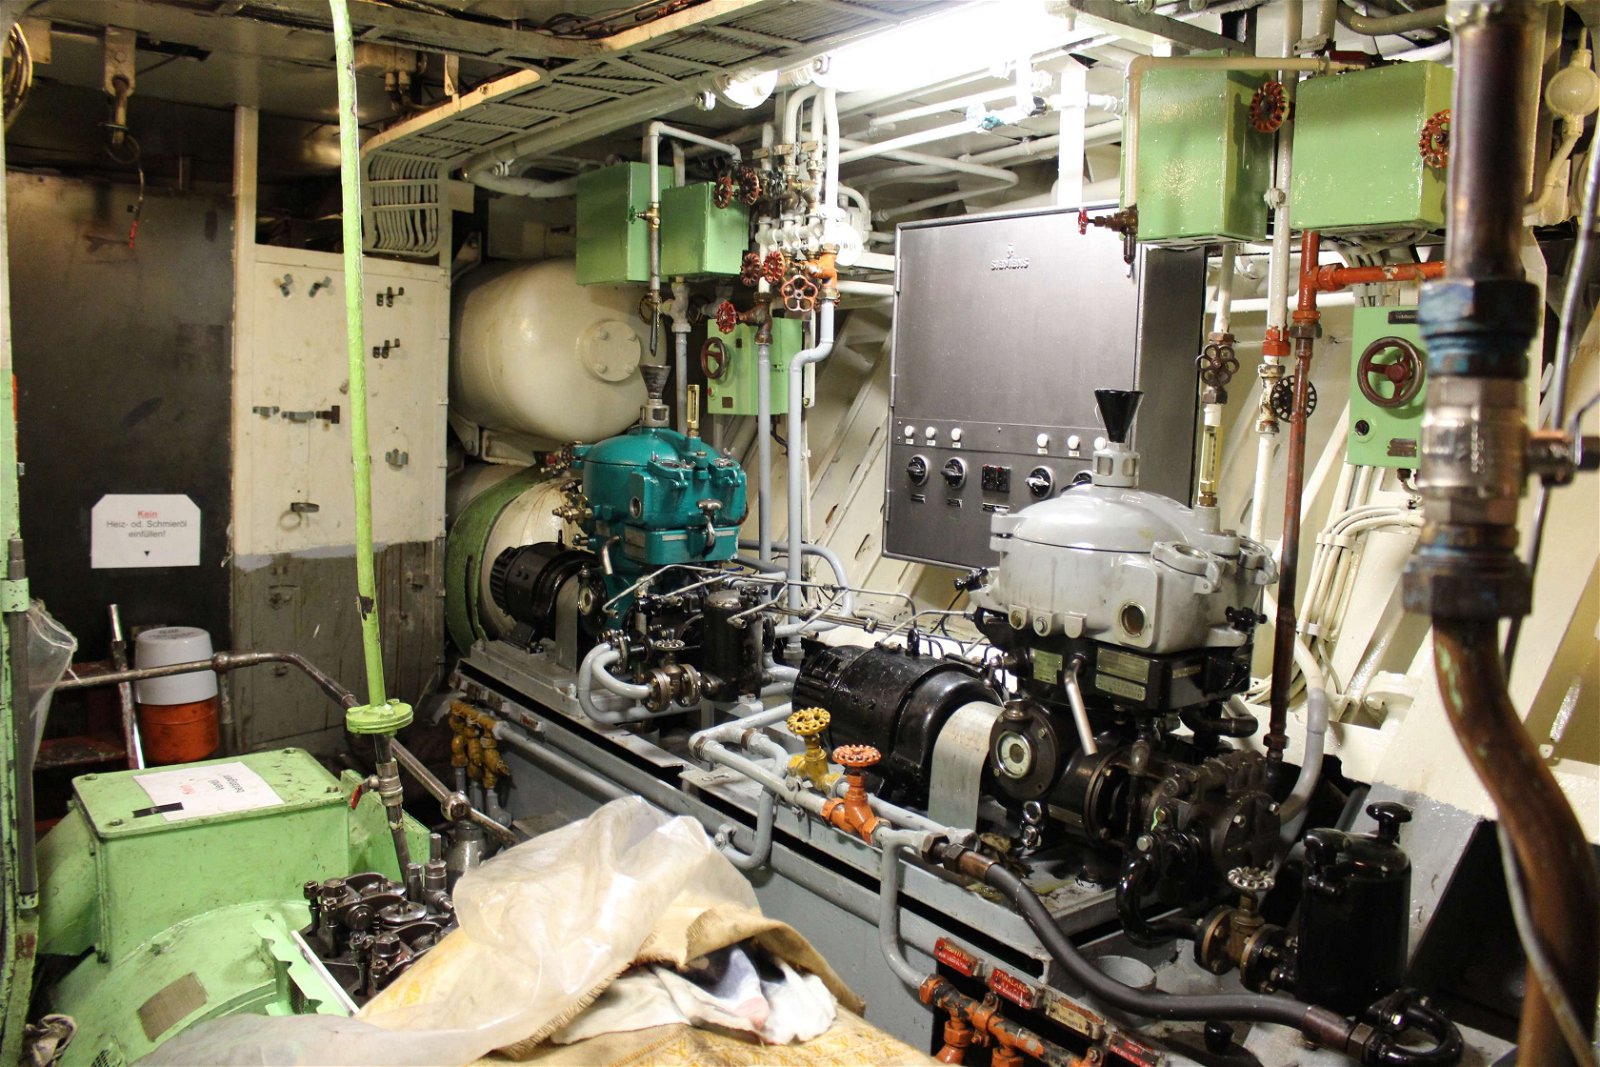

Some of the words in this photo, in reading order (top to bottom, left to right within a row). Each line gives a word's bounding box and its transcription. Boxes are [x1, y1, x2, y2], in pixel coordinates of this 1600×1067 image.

[991, 258, 1030, 271] SIEMENS
[137, 510, 158, 519] Kein
[106, 520, 128, 528] Heiz-
[146, 519, 187, 528] Schmieröl
[128, 529, 166, 538] einfüllen!
